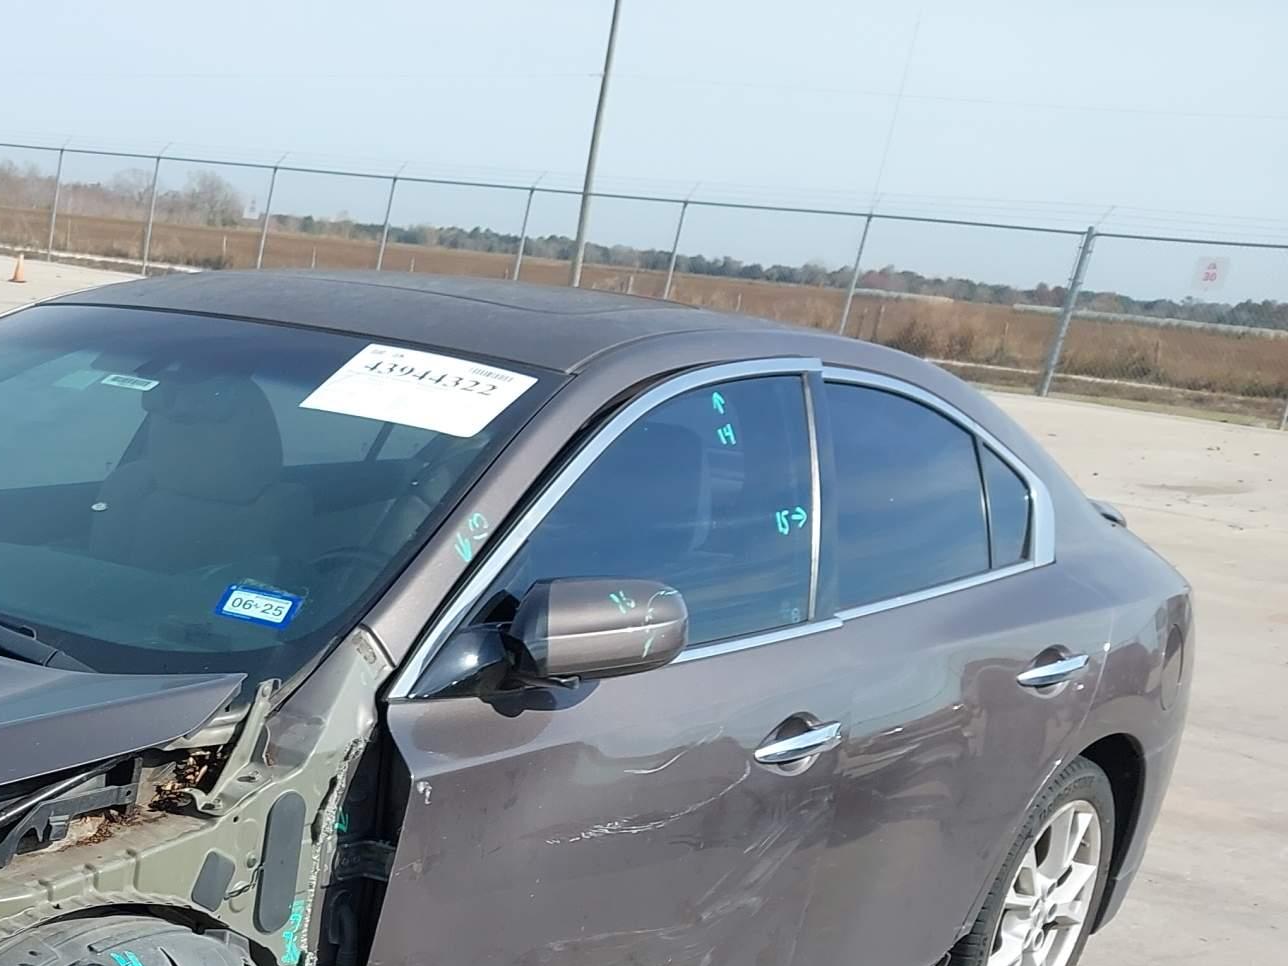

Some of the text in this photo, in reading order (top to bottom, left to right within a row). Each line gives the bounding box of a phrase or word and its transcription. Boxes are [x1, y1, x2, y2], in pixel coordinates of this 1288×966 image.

[364, 359, 499, 396] 43944322
[717, 423, 737, 445] 14
[775, 509, 790, 535] 15
[231, 597, 285, 617] 06 25
